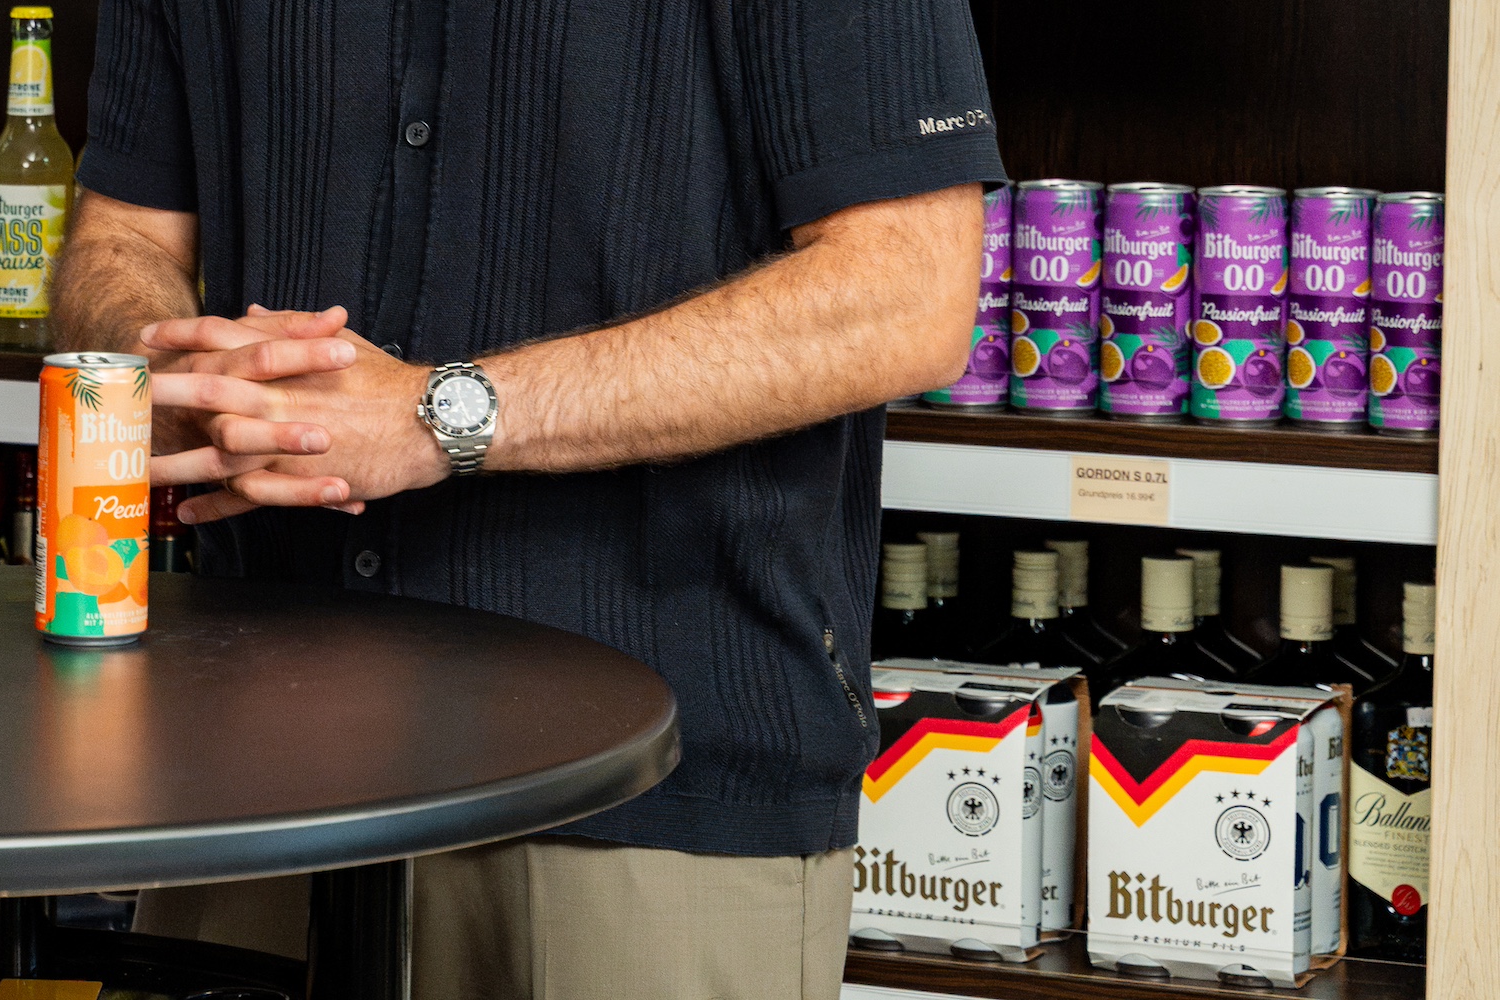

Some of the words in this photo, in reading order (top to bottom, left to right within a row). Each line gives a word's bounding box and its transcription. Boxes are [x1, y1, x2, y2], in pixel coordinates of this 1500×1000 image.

[918, 117, 965, 136] Marc
[1204, 232, 1283, 264] Bitburger
[1291, 232, 1366, 265] Bitburger
[1029, 255, 1069, 283] 0.0
[1114, 259, 1153, 287] 0.0
[1223, 264, 1264, 291] 0.0
[1305, 264, 1345, 292] 0.0
[1387, 271, 1426, 298] 0.0
[1202, 302, 1280, 326] Passionfruit
[1290, 302, 1365, 327] Passionfruit
[108, 448, 145, 481] 0.0
[1076, 467, 1130, 481] GORDON
[1133, 471, 1142, 482] S
[1145, 472, 1168, 484] 0.7L
[94, 495, 148, 520] Peach
[1078, 489, 1123, 500] Grundpreis
[853, 845, 1002, 912] Bitburger
[1196, 878, 1219, 891] Bitte
[1242, 872, 1262, 885] Bit
[1106, 870, 1275, 939] Bitburger
[1133, 935, 1201, 948] PREMIUM
[1212, 941, 1246, 952] PILS
